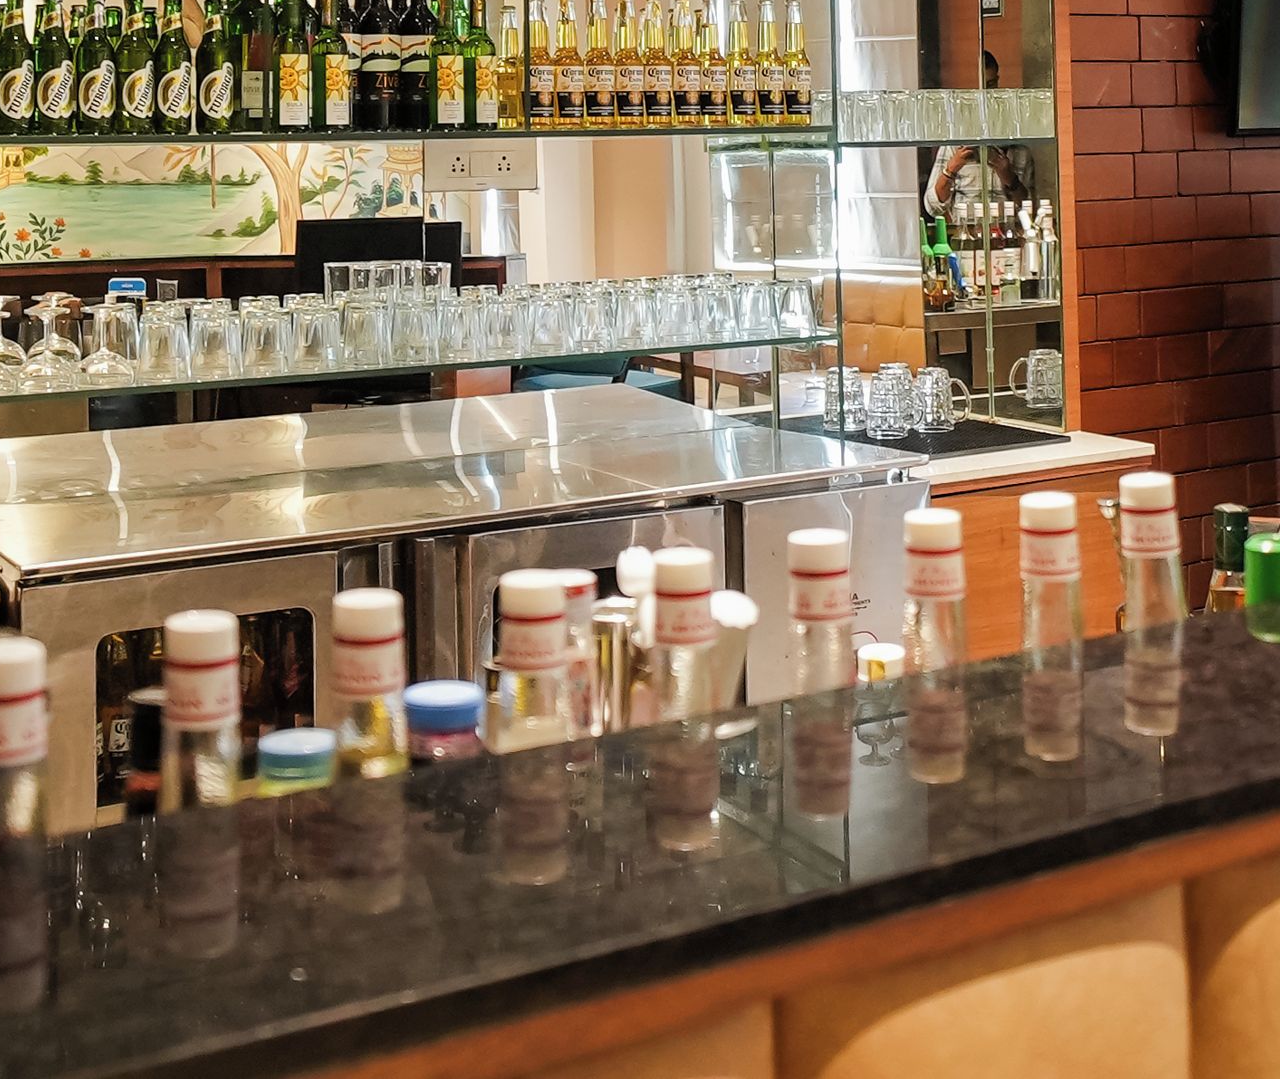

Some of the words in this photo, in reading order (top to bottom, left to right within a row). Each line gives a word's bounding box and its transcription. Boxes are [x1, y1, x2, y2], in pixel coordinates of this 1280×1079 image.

[7, 72, 33, 115] TUBORG
[45, 72, 72, 114] TUBORG
[87, 72, 113, 114] TUBORG
[133, 73, 154, 115] TUBORG
[166, 72, 191, 115] TUBORG
[207, 73, 232, 115] TUBORG
